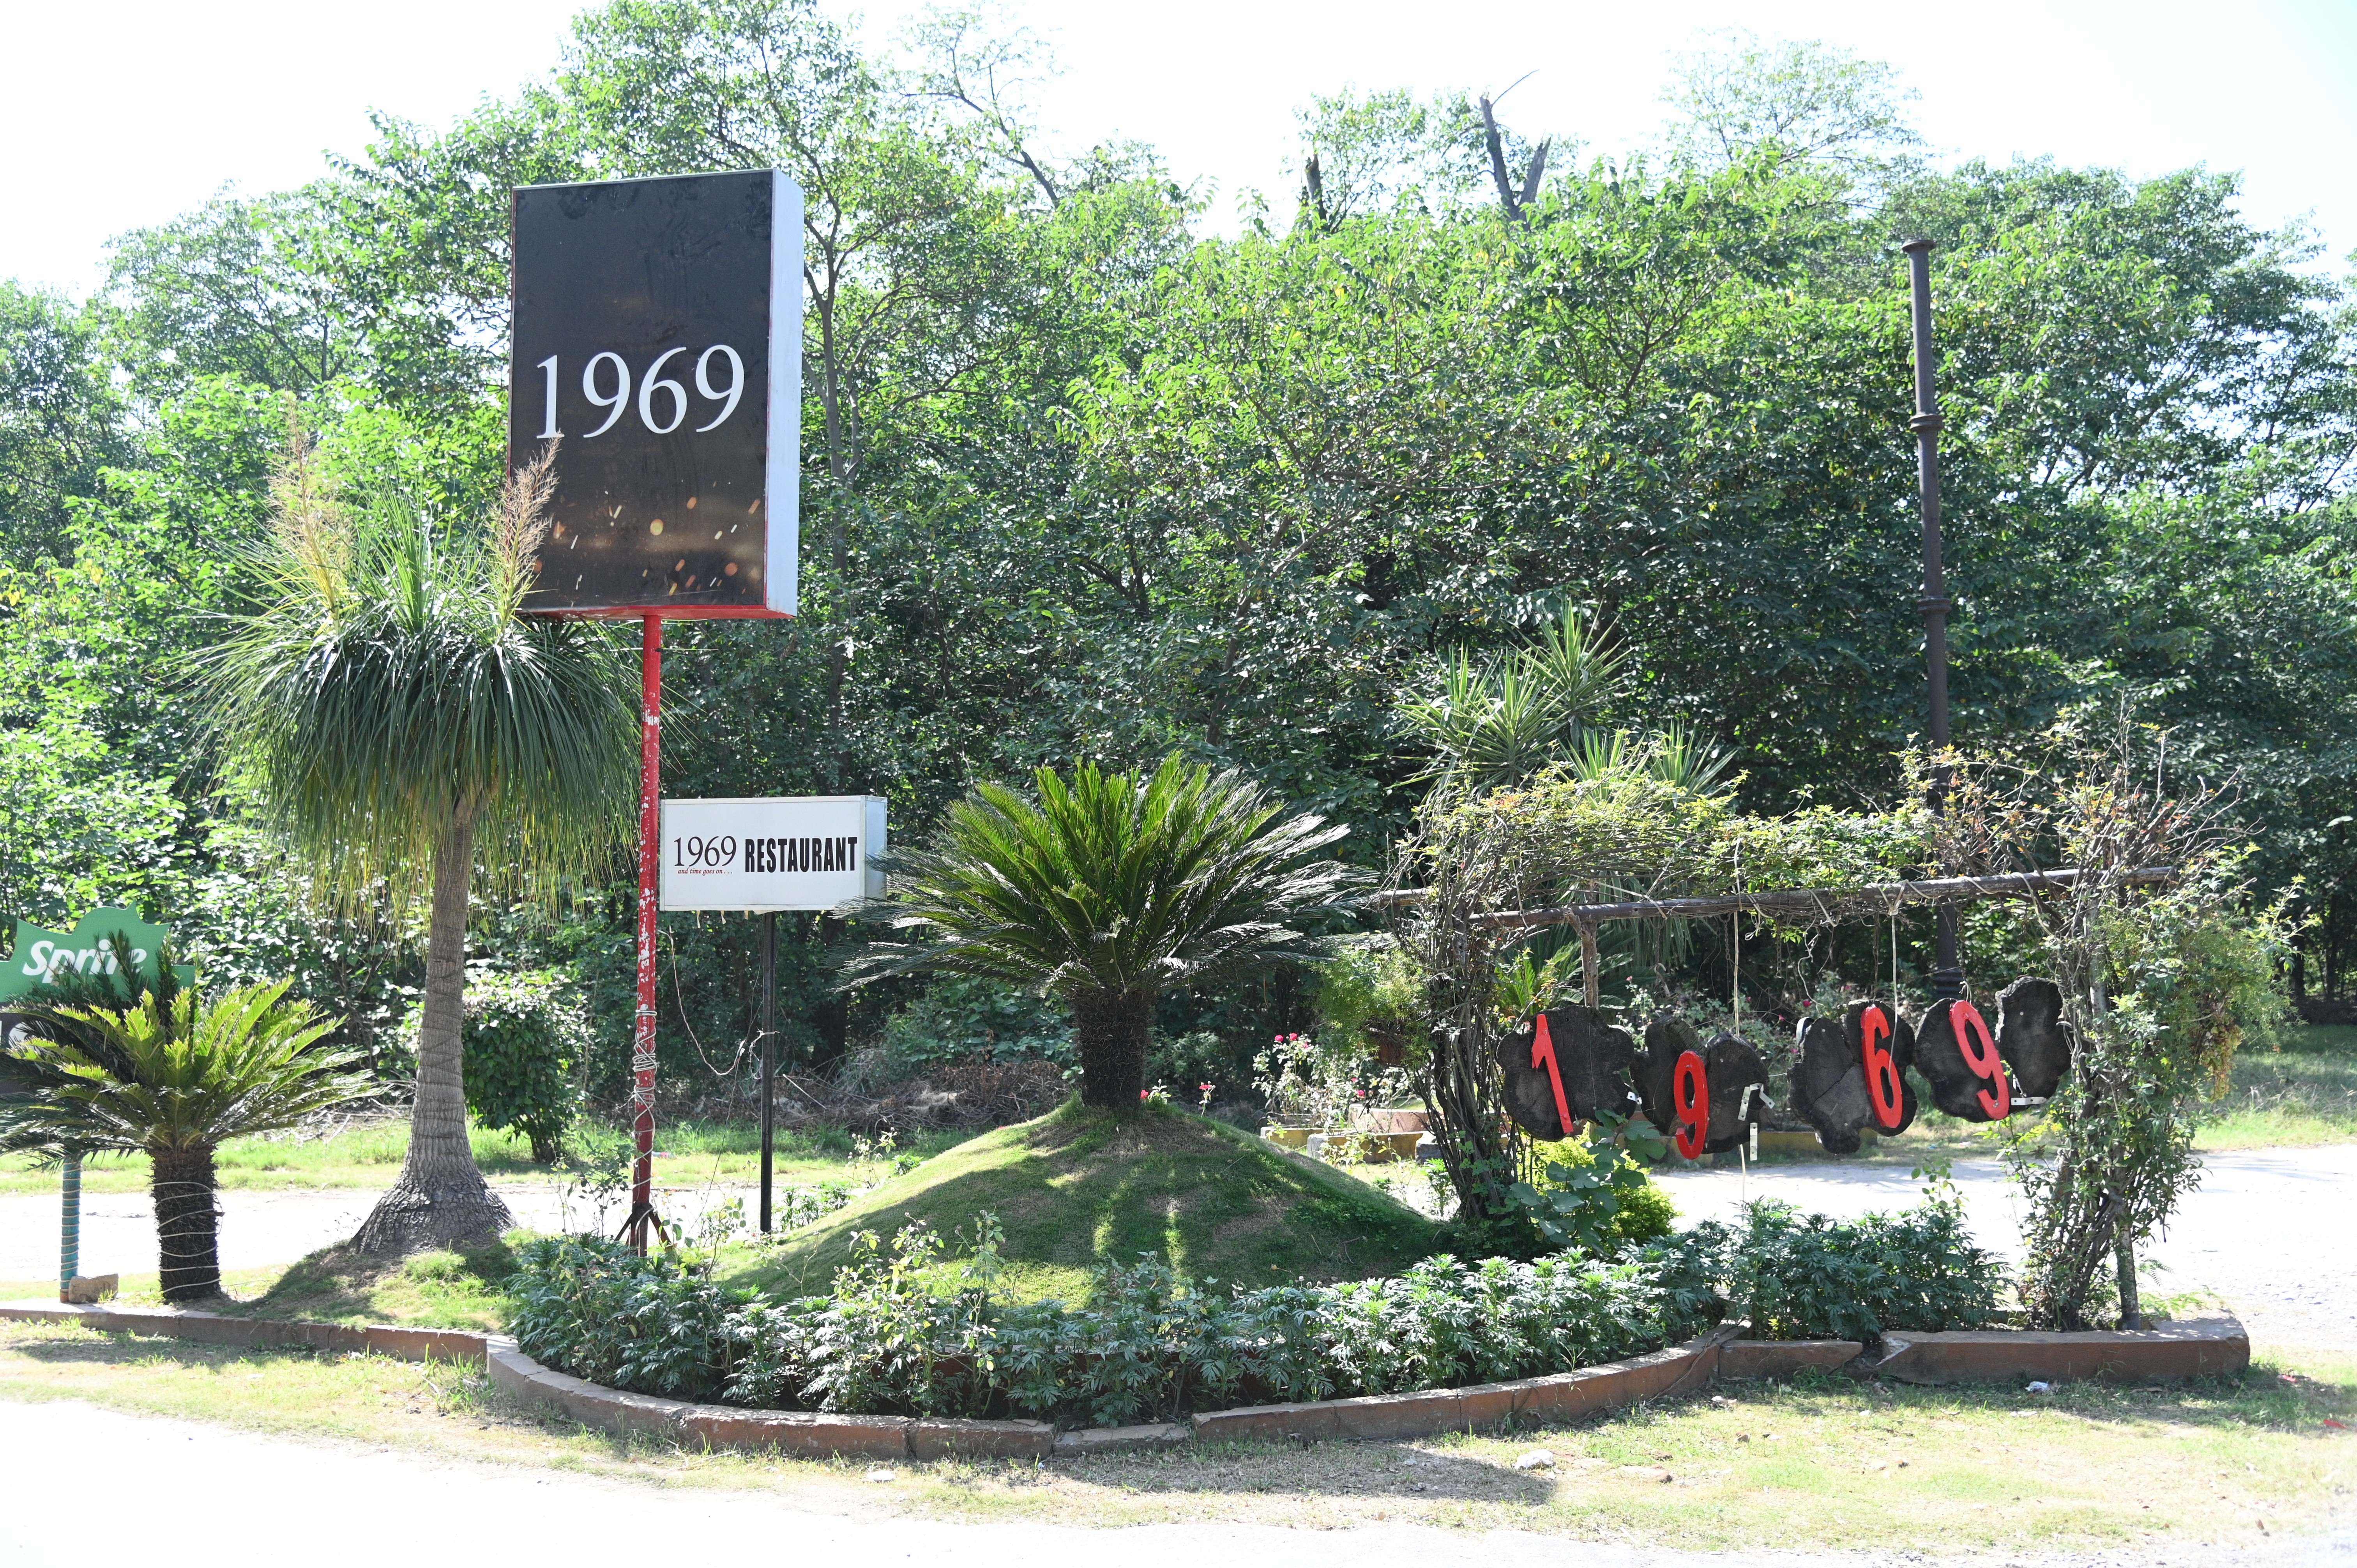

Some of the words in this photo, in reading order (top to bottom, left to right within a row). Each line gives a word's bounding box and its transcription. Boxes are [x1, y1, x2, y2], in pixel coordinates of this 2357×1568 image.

[536, 344, 745, 439] 1969
[674, 835, 737, 867] 1969
[745, 837, 857, 873] RESTAURANT
[22, 939, 147, 984] Sprite
